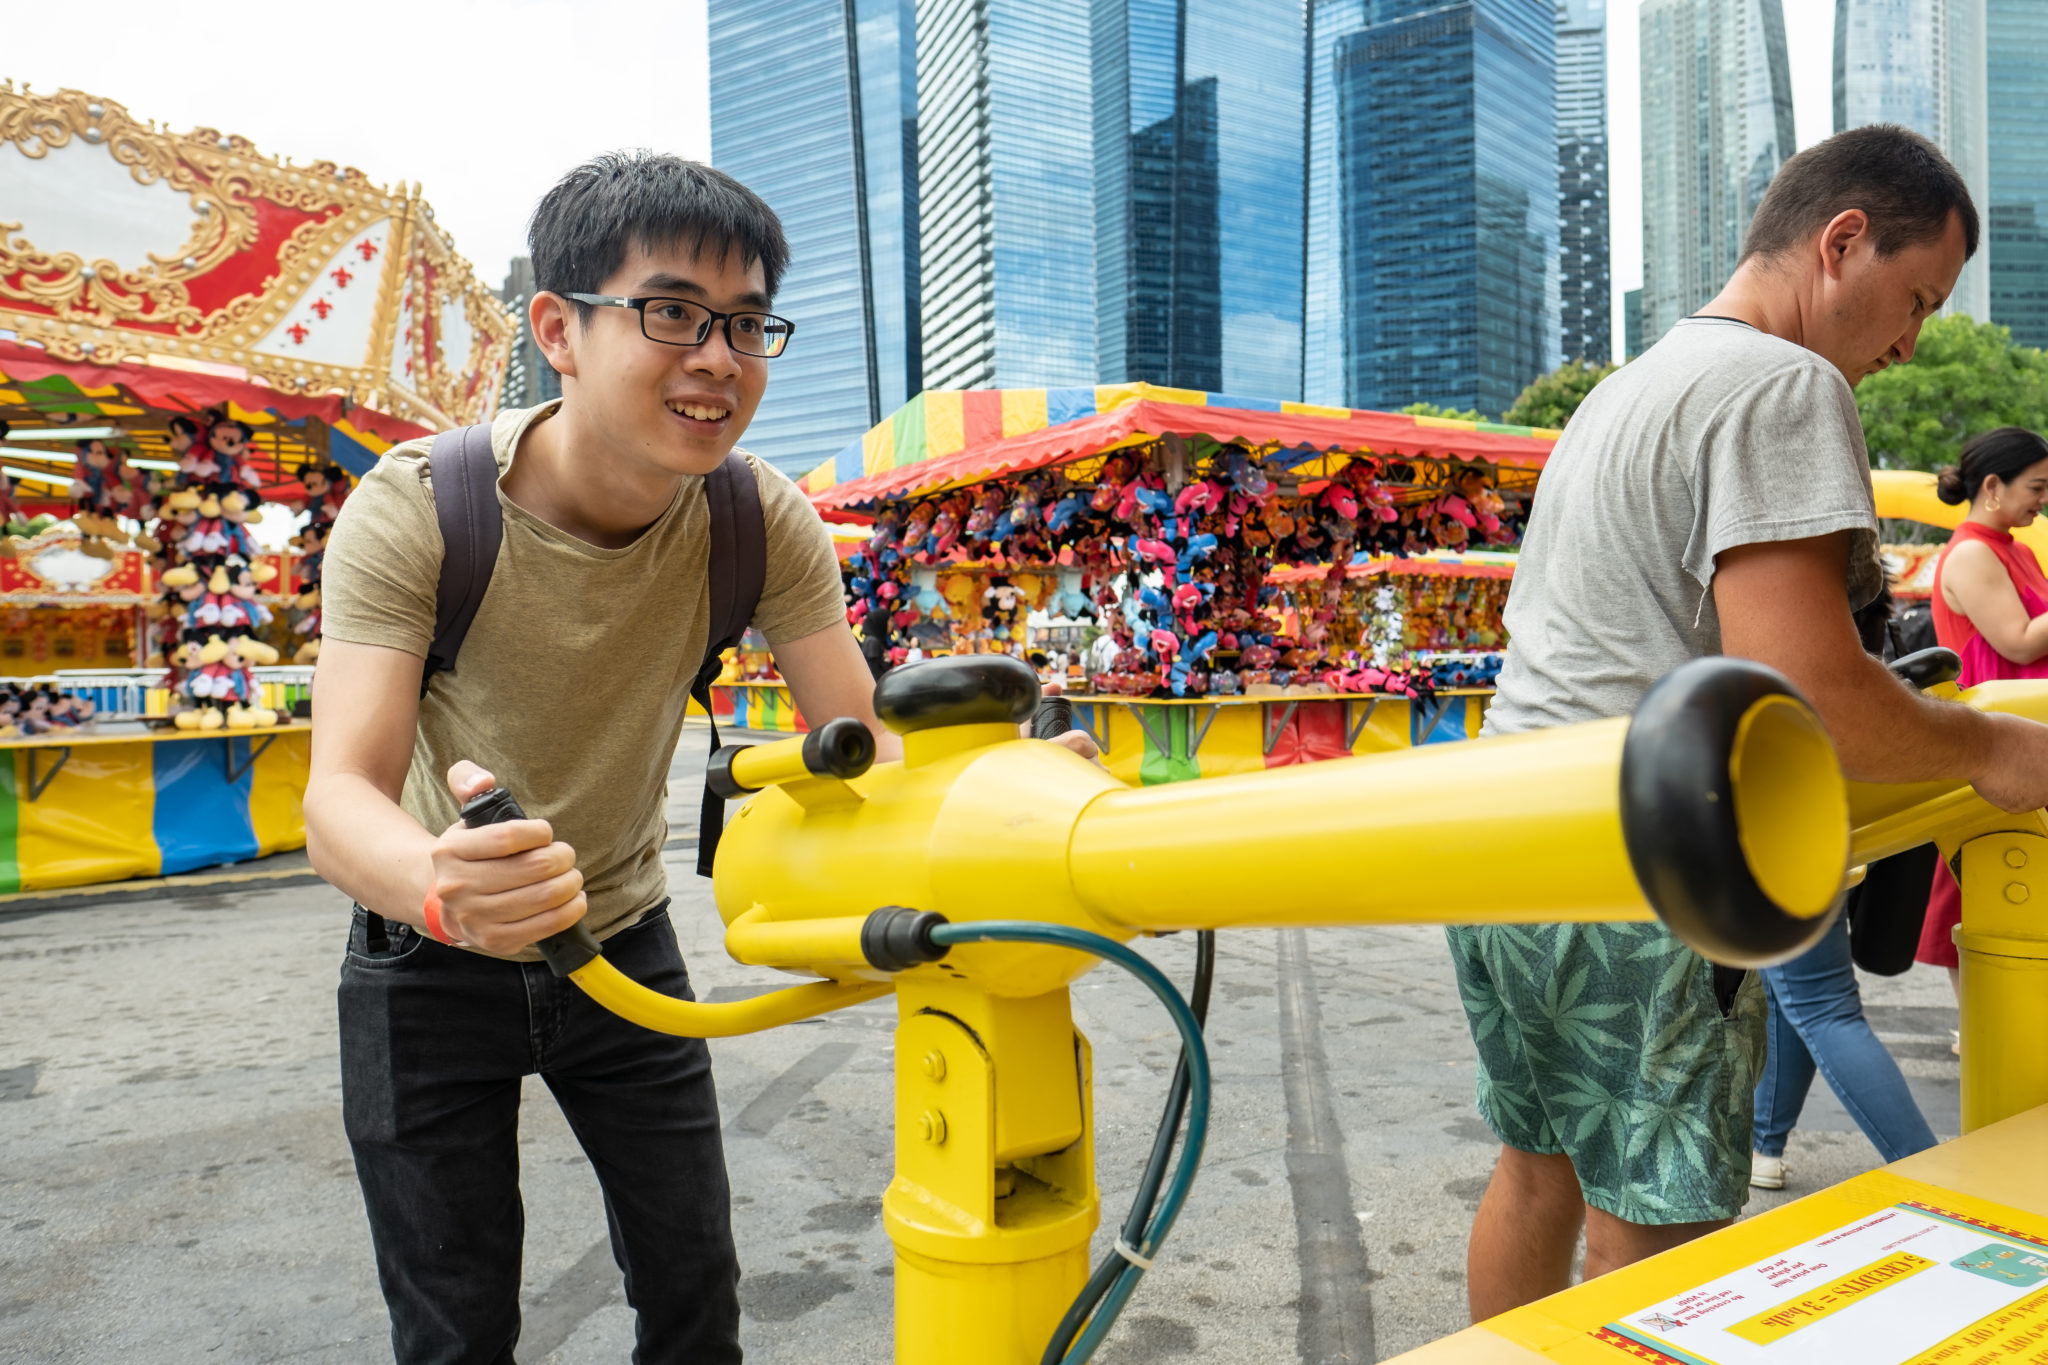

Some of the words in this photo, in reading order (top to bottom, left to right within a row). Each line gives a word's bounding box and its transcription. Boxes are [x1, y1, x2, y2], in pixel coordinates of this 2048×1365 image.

[1790, 1261, 1805, 1269] per
[1903, 1255, 1926, 1264] 5
[1757, 1265, 1774, 1273] day
[1809, 1263, 1828, 1271] One
[1766, 1267, 1791, 1280] player
[1790, 1268, 1810, 1279] prize
[1832, 1261, 1912, 1296] CREDITS
[1771, 1278, 1793, 1288] limit
[1818, 1294, 1838, 1303] =
[1672, 1305, 1694, 1316] game
[1696, 1299, 1731, 1314] crossing
[1801, 1300, 1825, 1311] 3
[1760, 1306, 1812, 1327] balls
[1995, 1316, 2011, 1324] or
[1986, 1323, 2004, 1332] 7
[1962, 1328, 1994, 1345] OFF
[2001, 1335, 2033, 1352] OFF
[1933, 1344, 1962, 1360] wins
